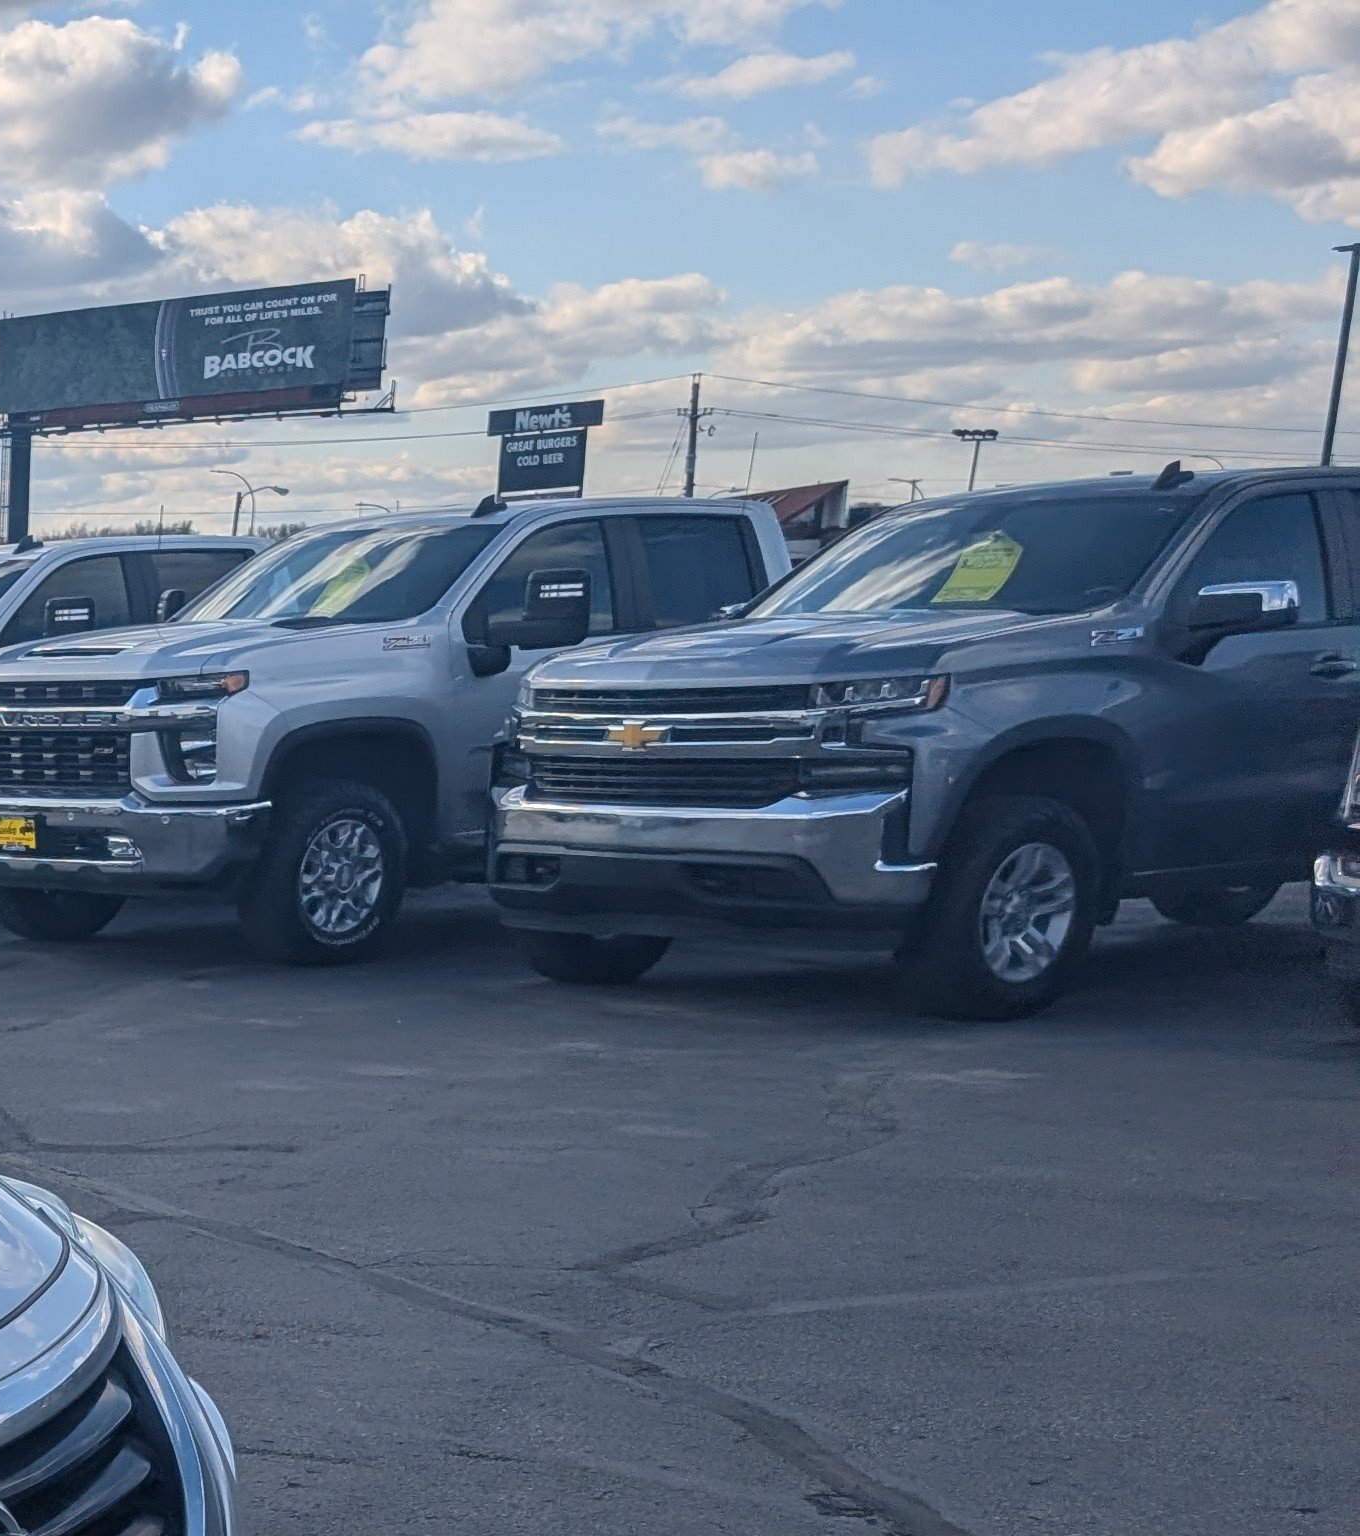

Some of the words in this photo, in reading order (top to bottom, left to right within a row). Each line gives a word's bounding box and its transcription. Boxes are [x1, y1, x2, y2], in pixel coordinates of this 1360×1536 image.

[189, 305, 220, 317] TRUST
[222, 304, 243, 314] YOU
[243, 301, 264, 311] CAN
[265, 297, 299, 309] COUNT
[301, 295, 315, 304] ON
[317, 293, 338, 303] FOR
[204, 316, 224, 326] FOR
[225, 314, 243, 323] ALL
[244, 312, 258, 322] OF
[203, 345, 316, 379] BABCOCK
[515, 405, 572, 431] Newt's
[505, 440, 535, 453] GREAT
[536, 436, 578, 450] BURGERS
[516, 455, 540, 467] COLD
[542, 452, 564, 465] BEER
